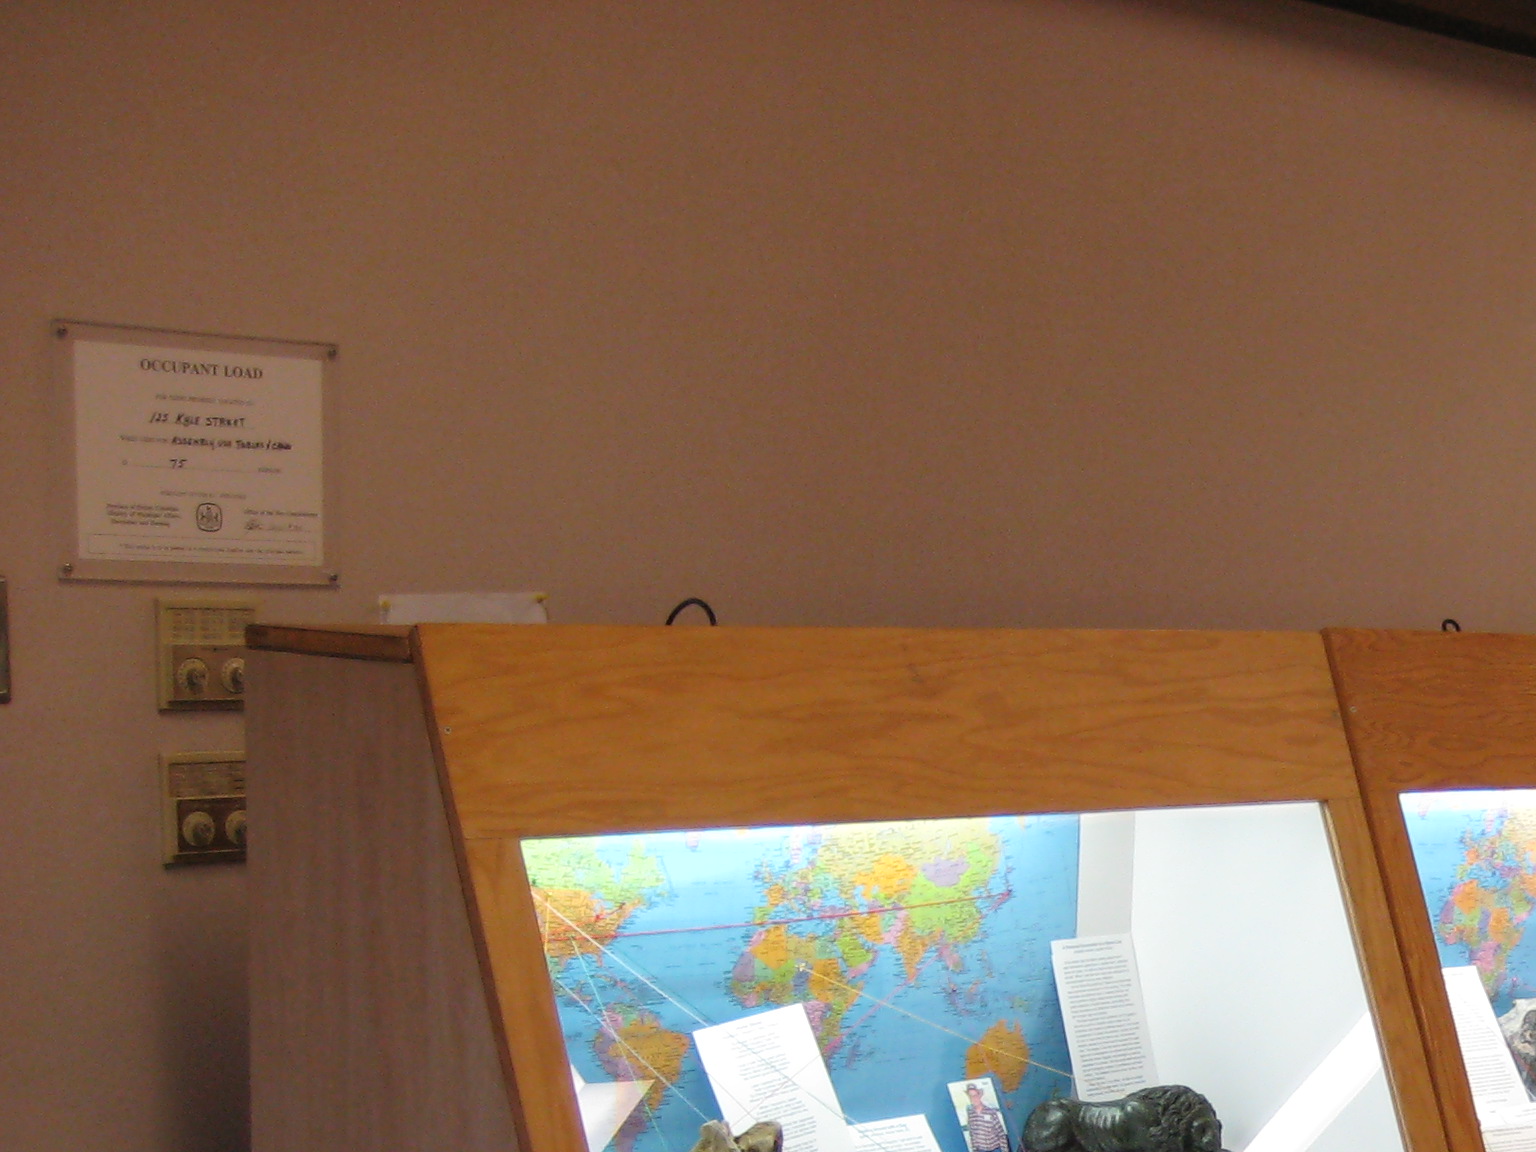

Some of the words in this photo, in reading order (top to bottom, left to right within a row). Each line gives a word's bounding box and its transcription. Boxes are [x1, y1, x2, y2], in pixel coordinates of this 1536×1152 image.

[140, 359, 218, 377] OCCUPANT
[224, 368, 263, 379] LOAD
[170, 459, 187, 469] 75
